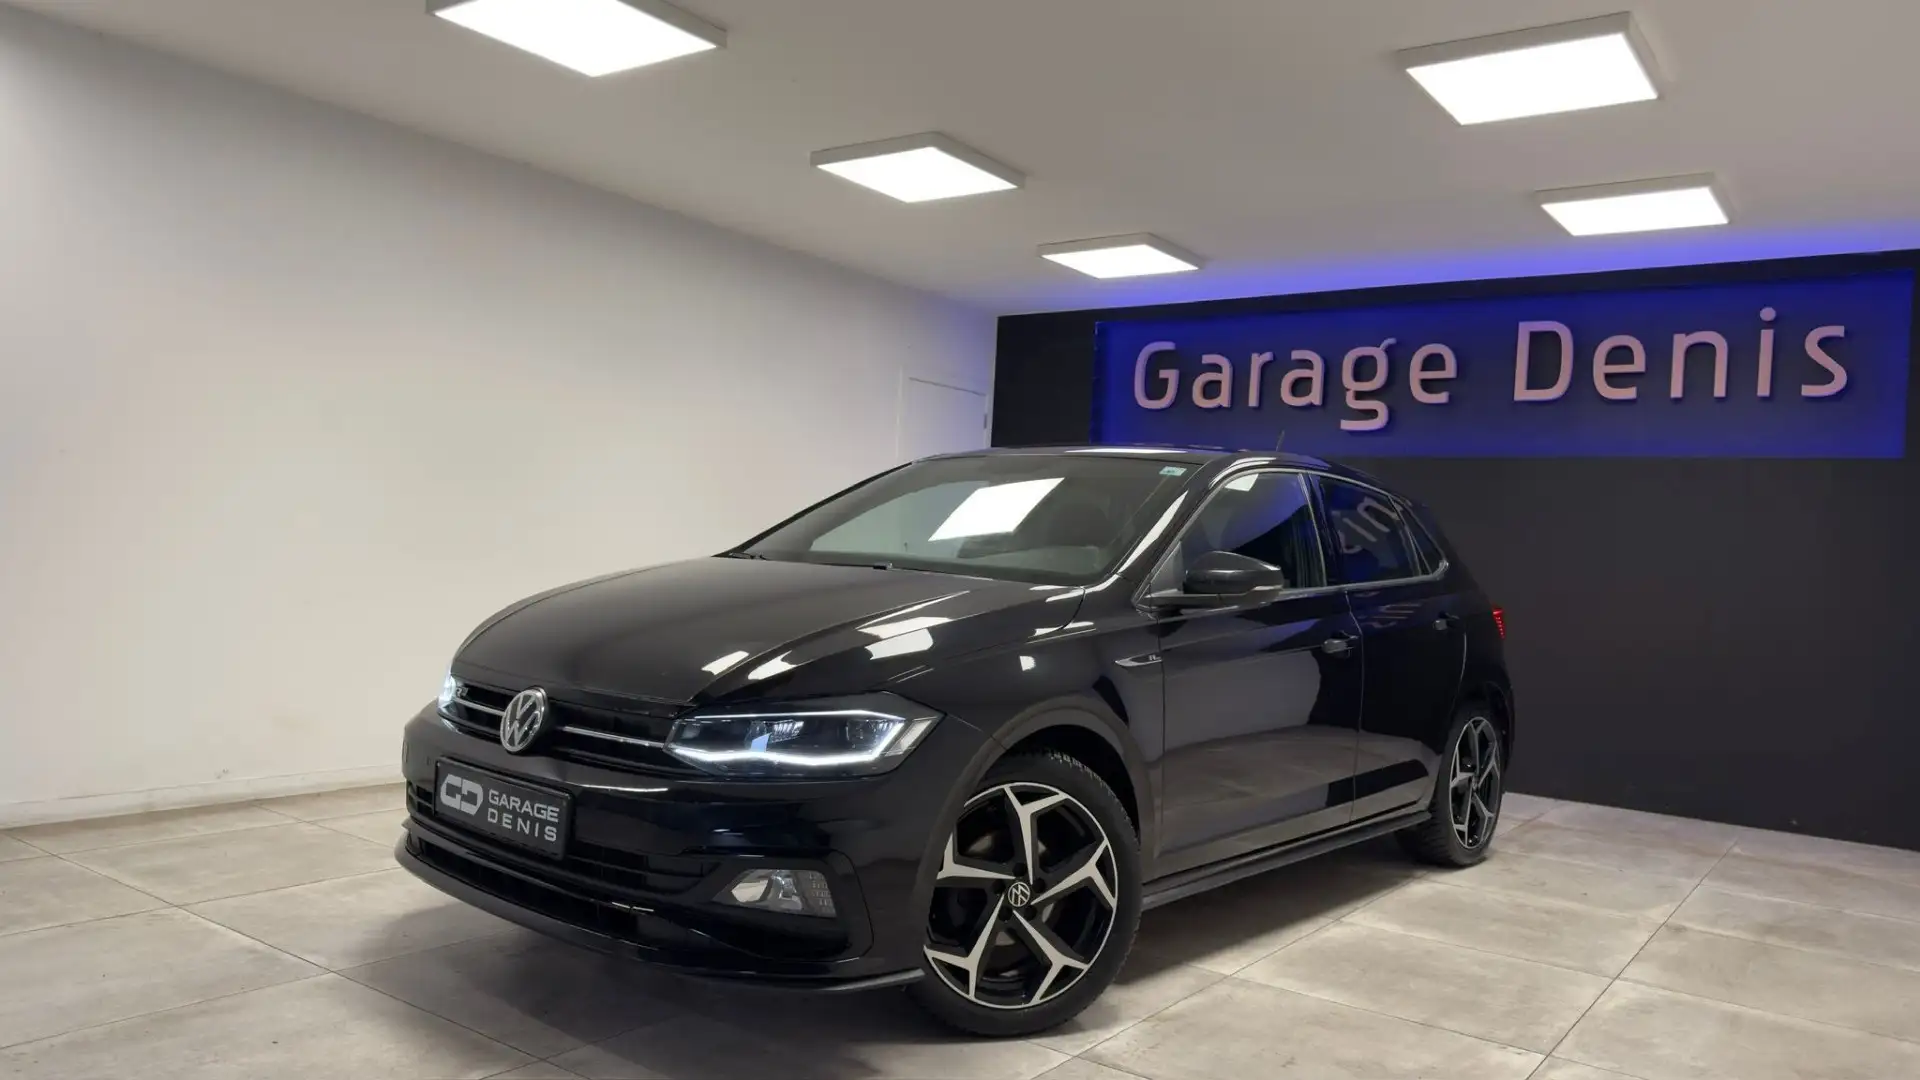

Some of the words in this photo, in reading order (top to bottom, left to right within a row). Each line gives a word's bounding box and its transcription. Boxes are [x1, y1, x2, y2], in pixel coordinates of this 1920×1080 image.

[1132, 336, 1458, 431] Garage
[1513, 307, 1848, 401] Denis
[488, 789, 559, 823] GARAGE
[487, 808, 558, 842] DENIS
